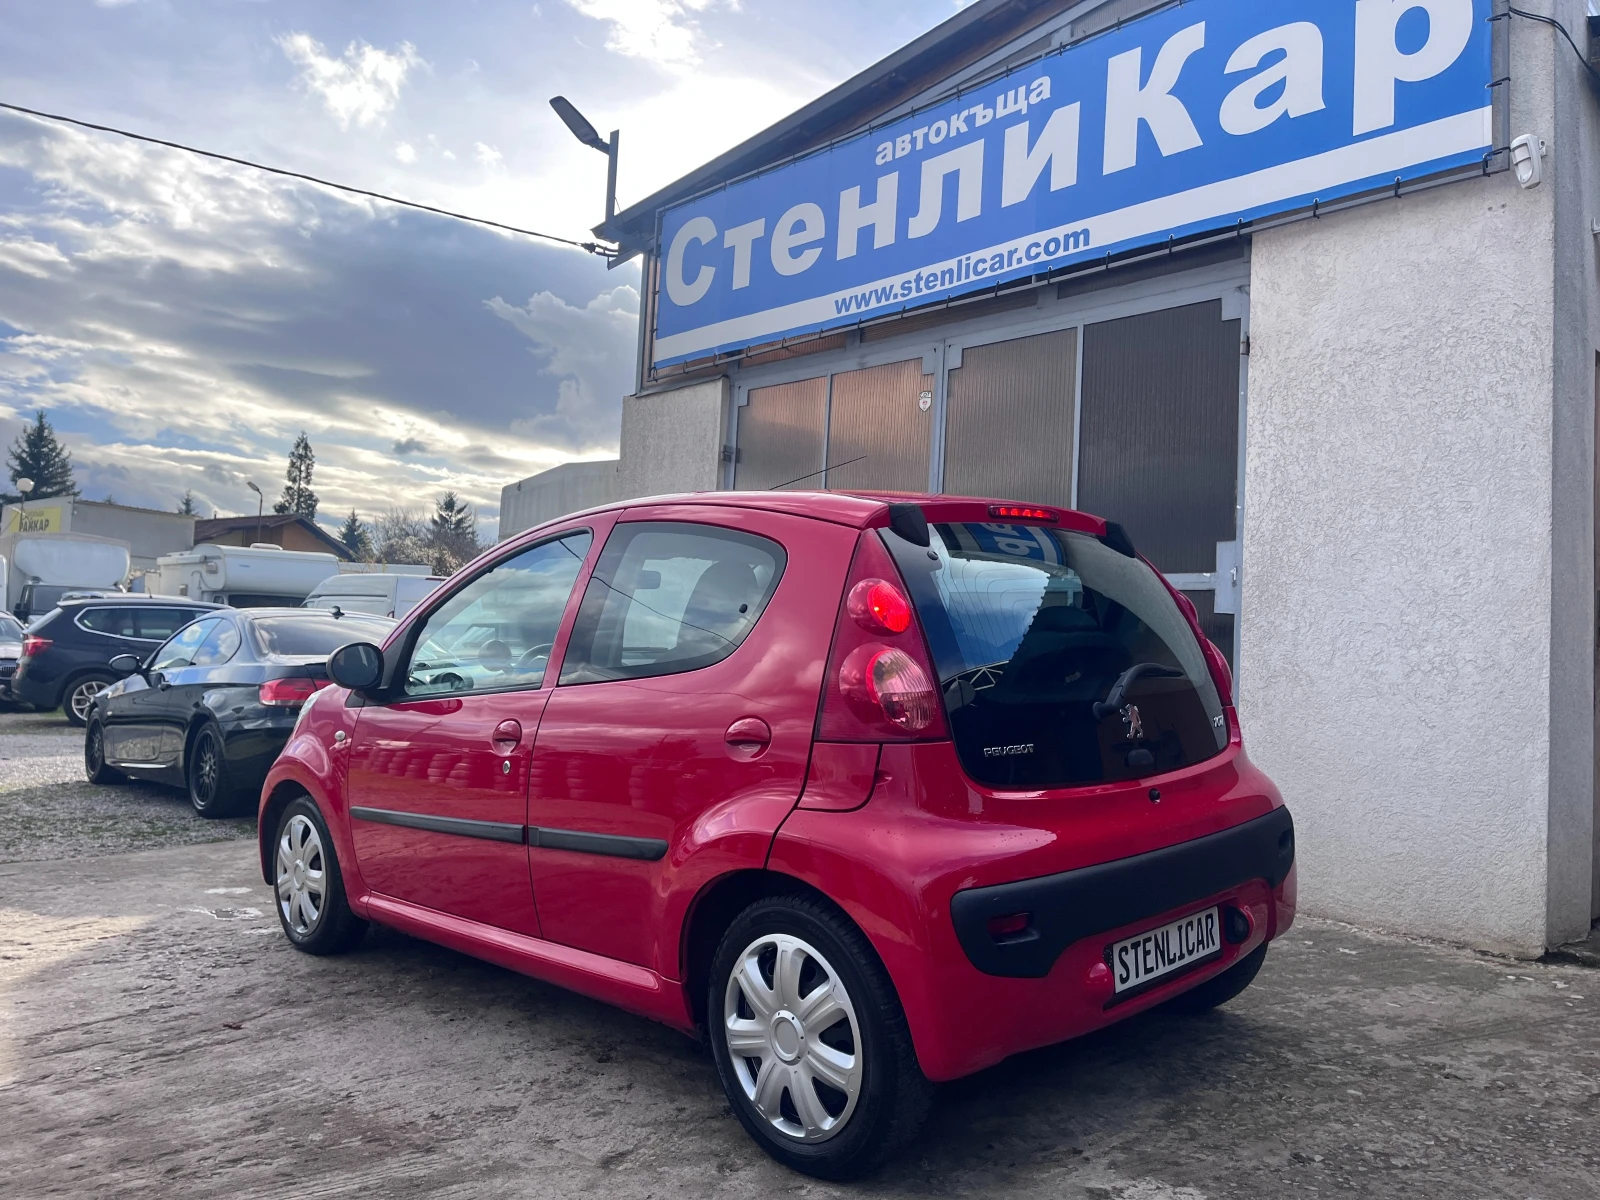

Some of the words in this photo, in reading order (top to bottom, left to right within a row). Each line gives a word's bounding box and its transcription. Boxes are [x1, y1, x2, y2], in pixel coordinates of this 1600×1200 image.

[875, 75, 1051, 166] автокъща
[834, 228, 1090, 314] www.stenlicar.com
[983, 743, 1035, 758] PEUGEOT
[1117, 913, 1215, 985] STENLICAR
